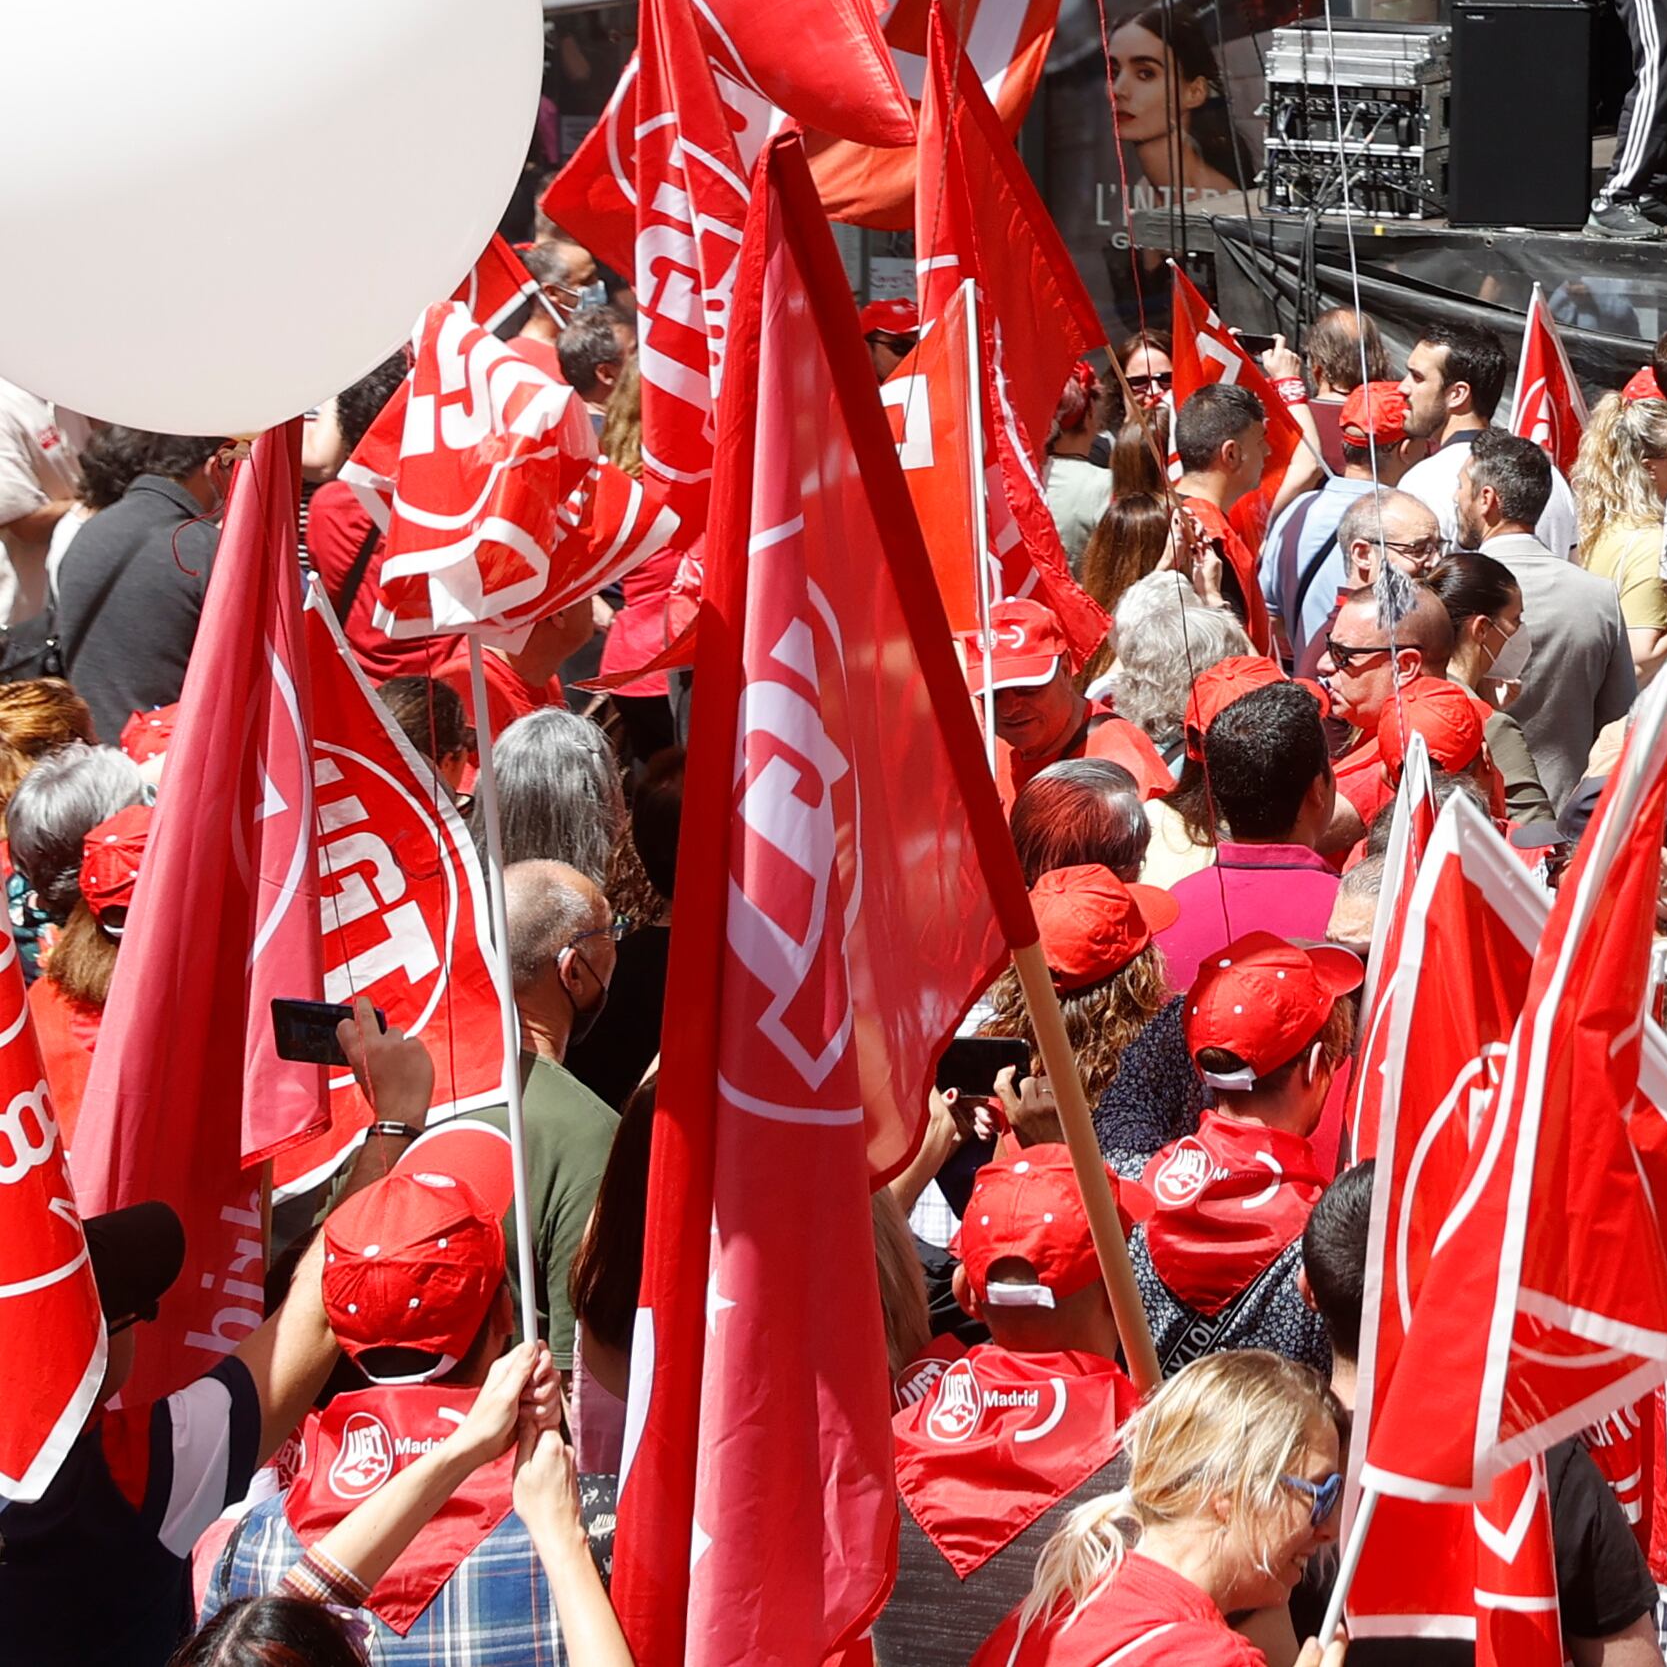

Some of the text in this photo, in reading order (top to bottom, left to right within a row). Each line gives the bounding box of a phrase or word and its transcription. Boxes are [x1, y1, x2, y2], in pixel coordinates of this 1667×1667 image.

[1174, 1148, 1210, 1179] UGT
[943, 1372, 1039, 1411] UGT Madrid
[348, 1423, 388, 1460] UGT
